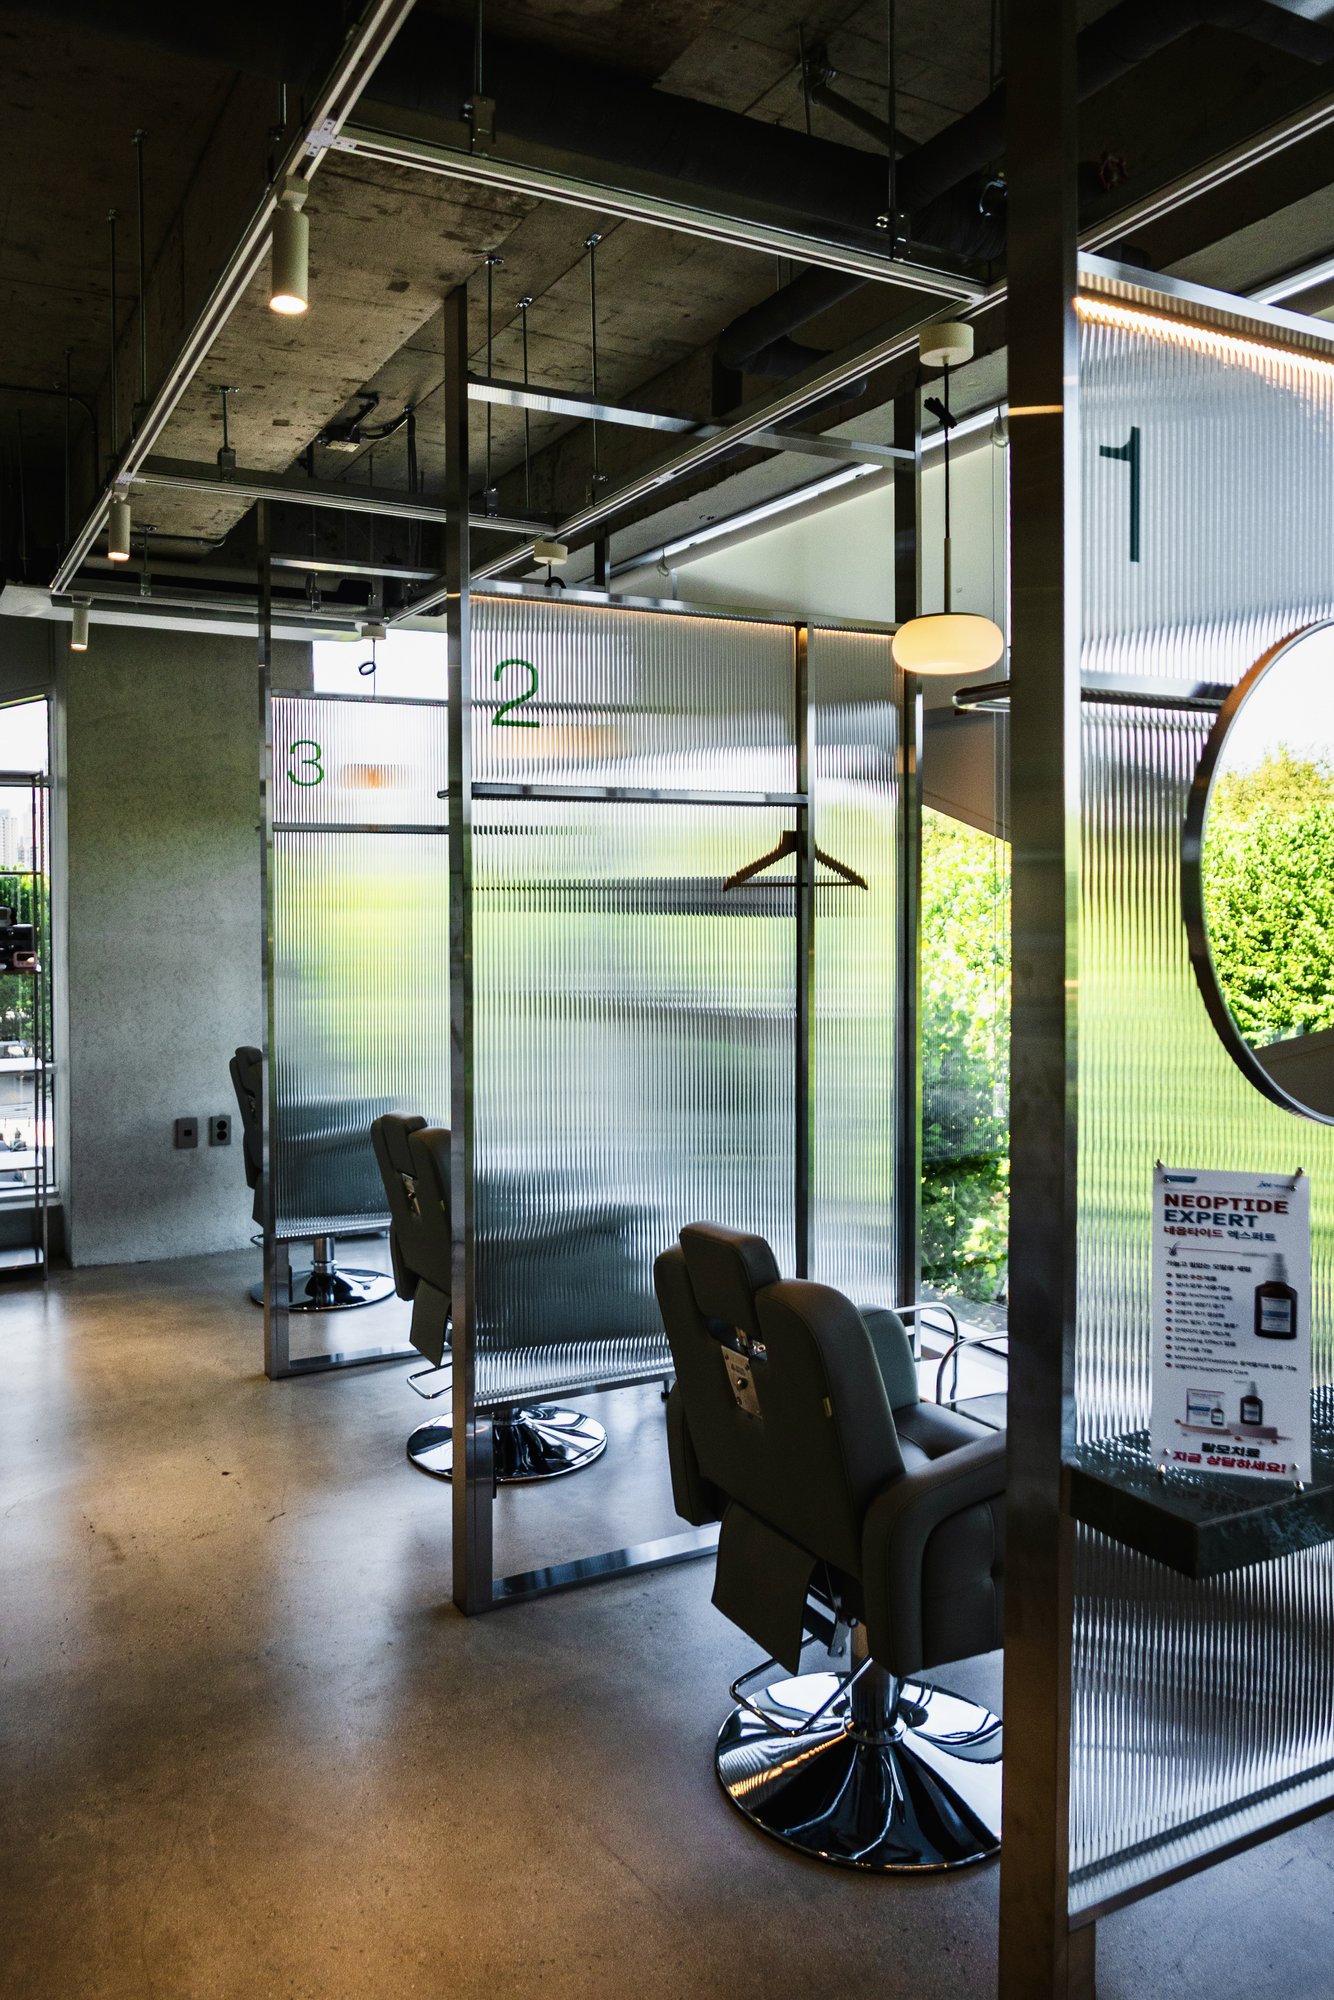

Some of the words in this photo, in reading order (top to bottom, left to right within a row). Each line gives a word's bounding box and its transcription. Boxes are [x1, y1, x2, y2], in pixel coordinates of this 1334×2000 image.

[1099, 425, 1140, 563] 1
[491, 658, 541, 728] 2
[286, 739, 325, 787] 3
[1164, 1193, 1289, 1214] NEOPTIDE
[1164, 1209, 1258, 1228] EXPERT
[1172, 1450, 1202, 1464] 지금
[1206, 1455, 1287, 1474] 상담하세요!
